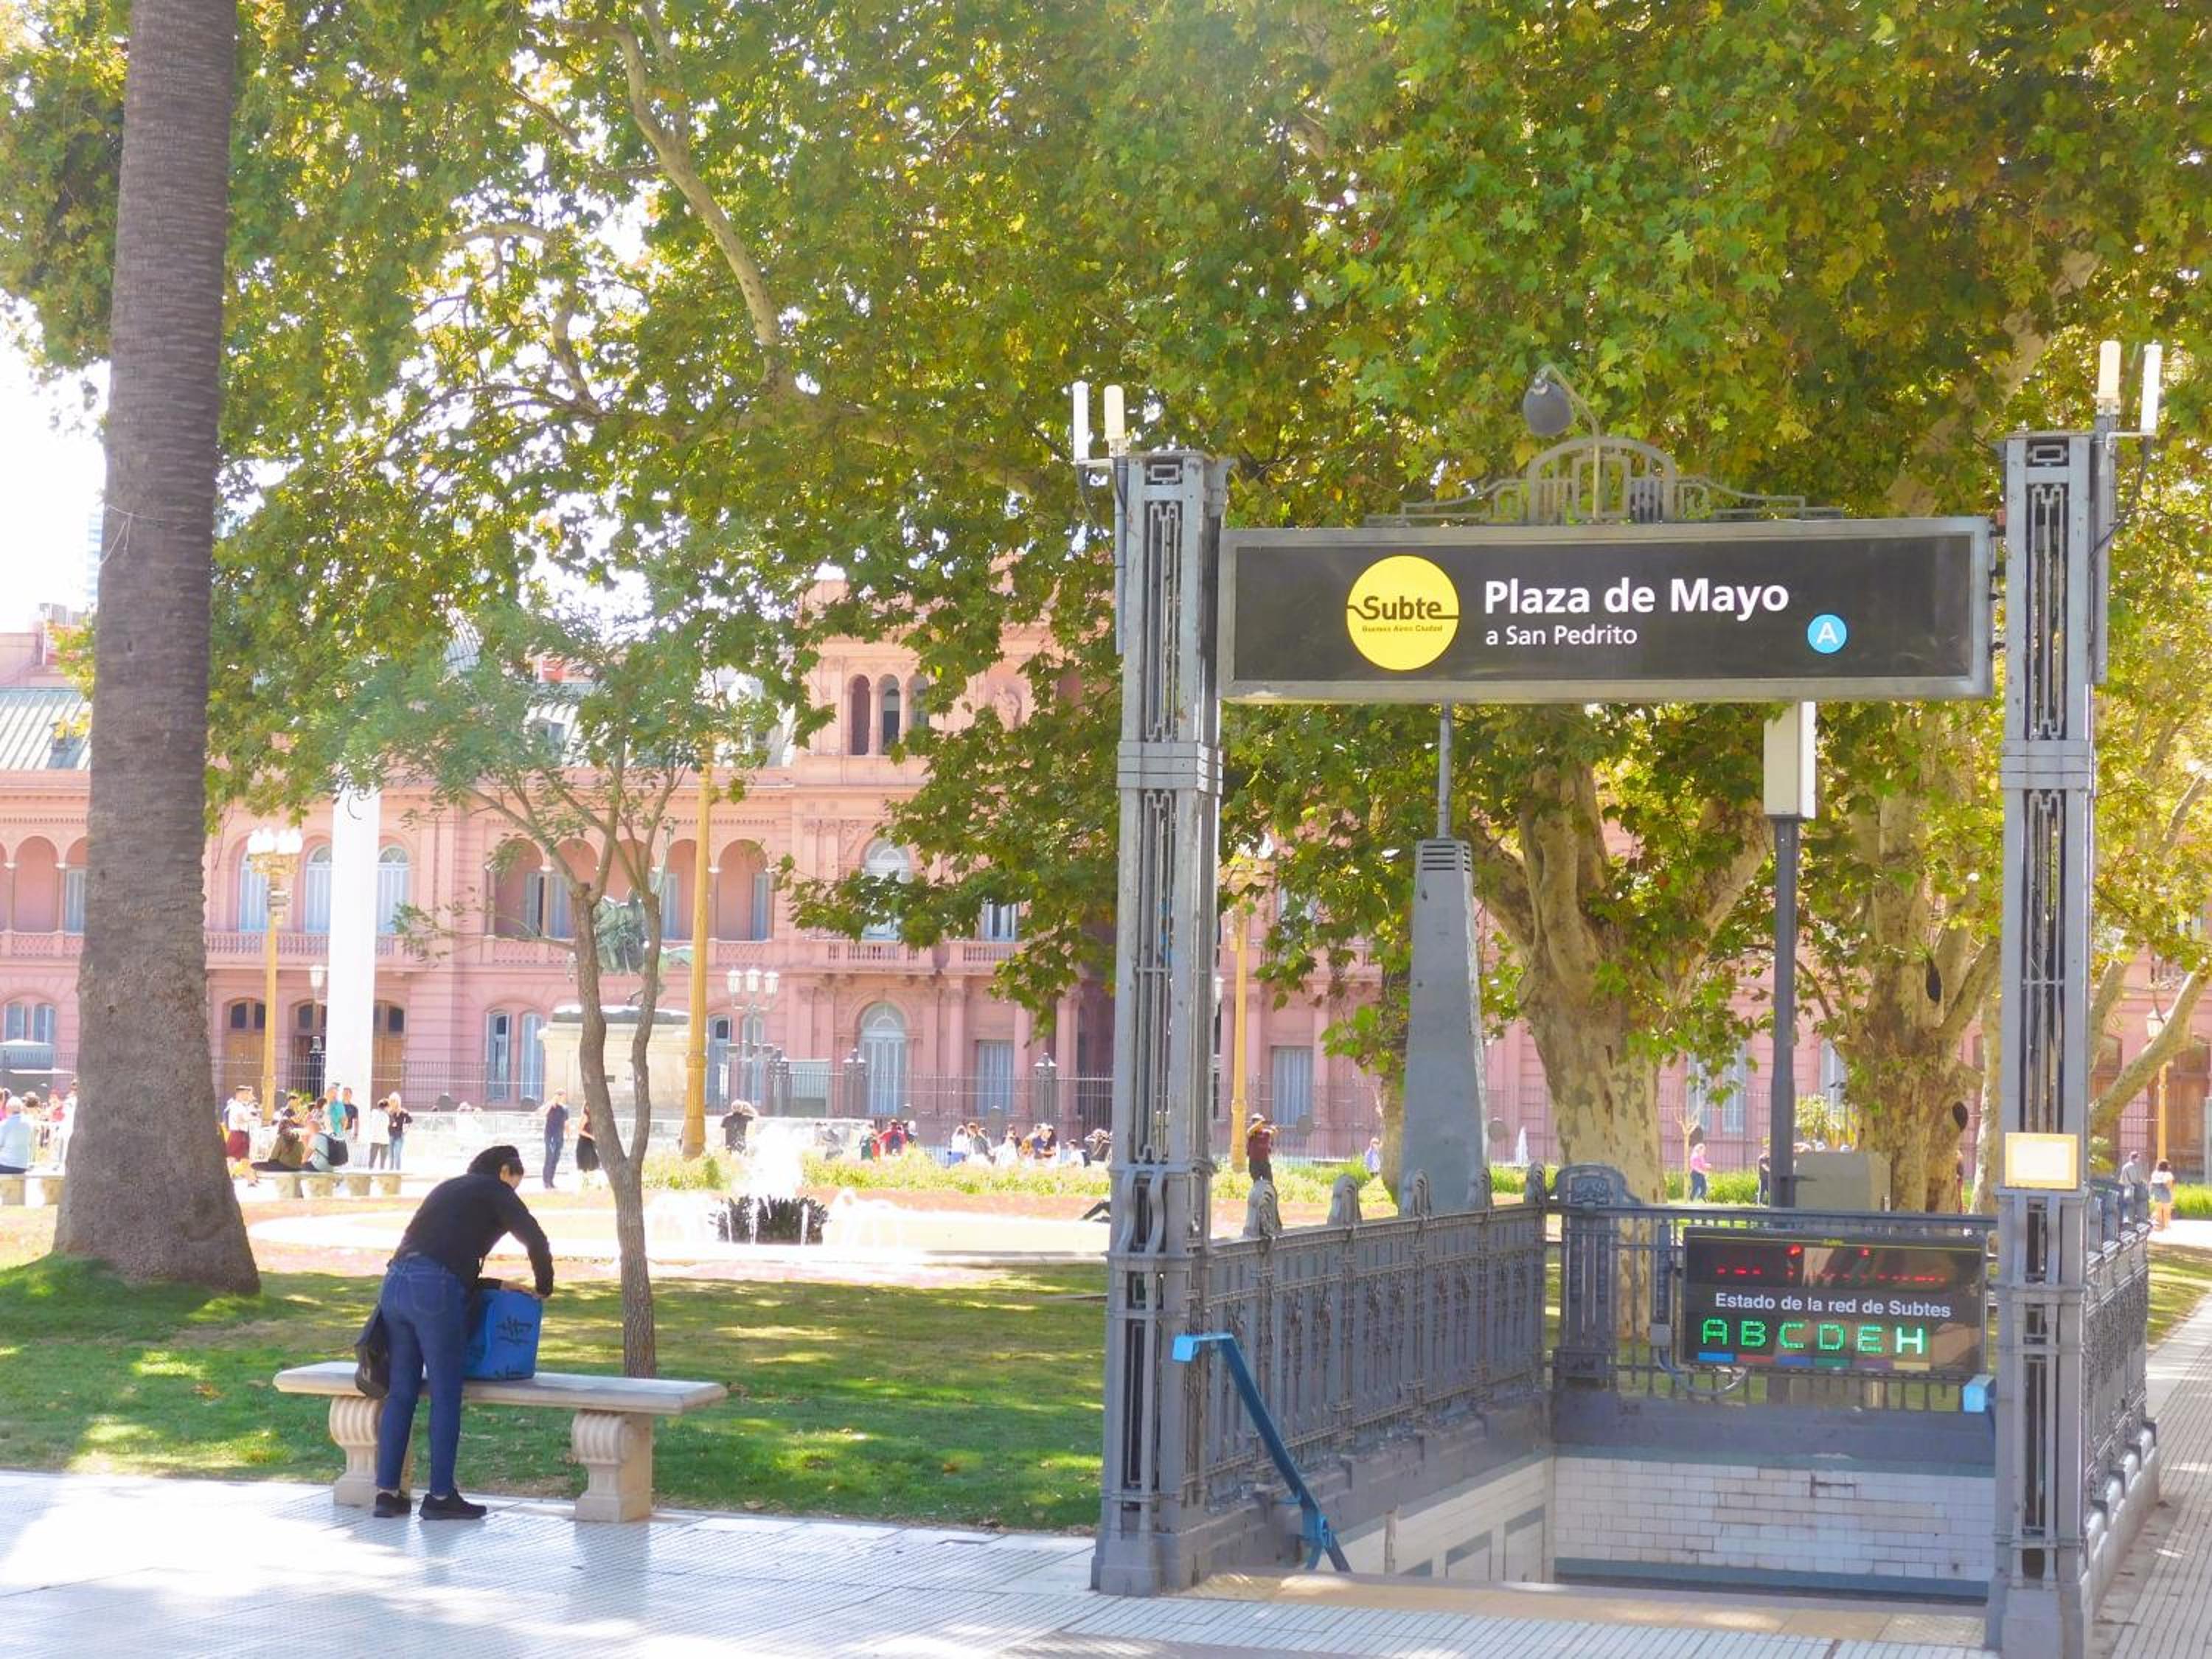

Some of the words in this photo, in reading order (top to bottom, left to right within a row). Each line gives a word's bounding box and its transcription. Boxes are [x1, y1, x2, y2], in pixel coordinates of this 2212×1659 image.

[1363, 595, 1444, 620] Subte
[1485, 578, 1590, 613] Plaza
[1604, 577, 1655, 613] de
[1671, 578, 1790, 621] Mayo
[1486, 630, 1498, 645] a
[1506, 626, 1546, 645] San
[1554, 625, 1638, 644] Pedrito
[1817, 622, 1838, 644] A
[1716, 1293, 1775, 1309] Estado
[1781, 1295, 1803, 1310] de
[1808, 1297, 1823, 1312] la
[1828, 1298, 1857, 1313] red
[1862, 1299, 1884, 1315] de
[1888, 1300, 1952, 1318] Subtes
[1702, 1318, 1728, 1345] A
[1741, 1321, 1766, 1346] B
[1779, 1322, 1806, 1349] C
[1818, 1324, 1844, 1351] D
[1857, 1324, 1883, 1353] E
[1896, 1326, 1924, 1354] H
